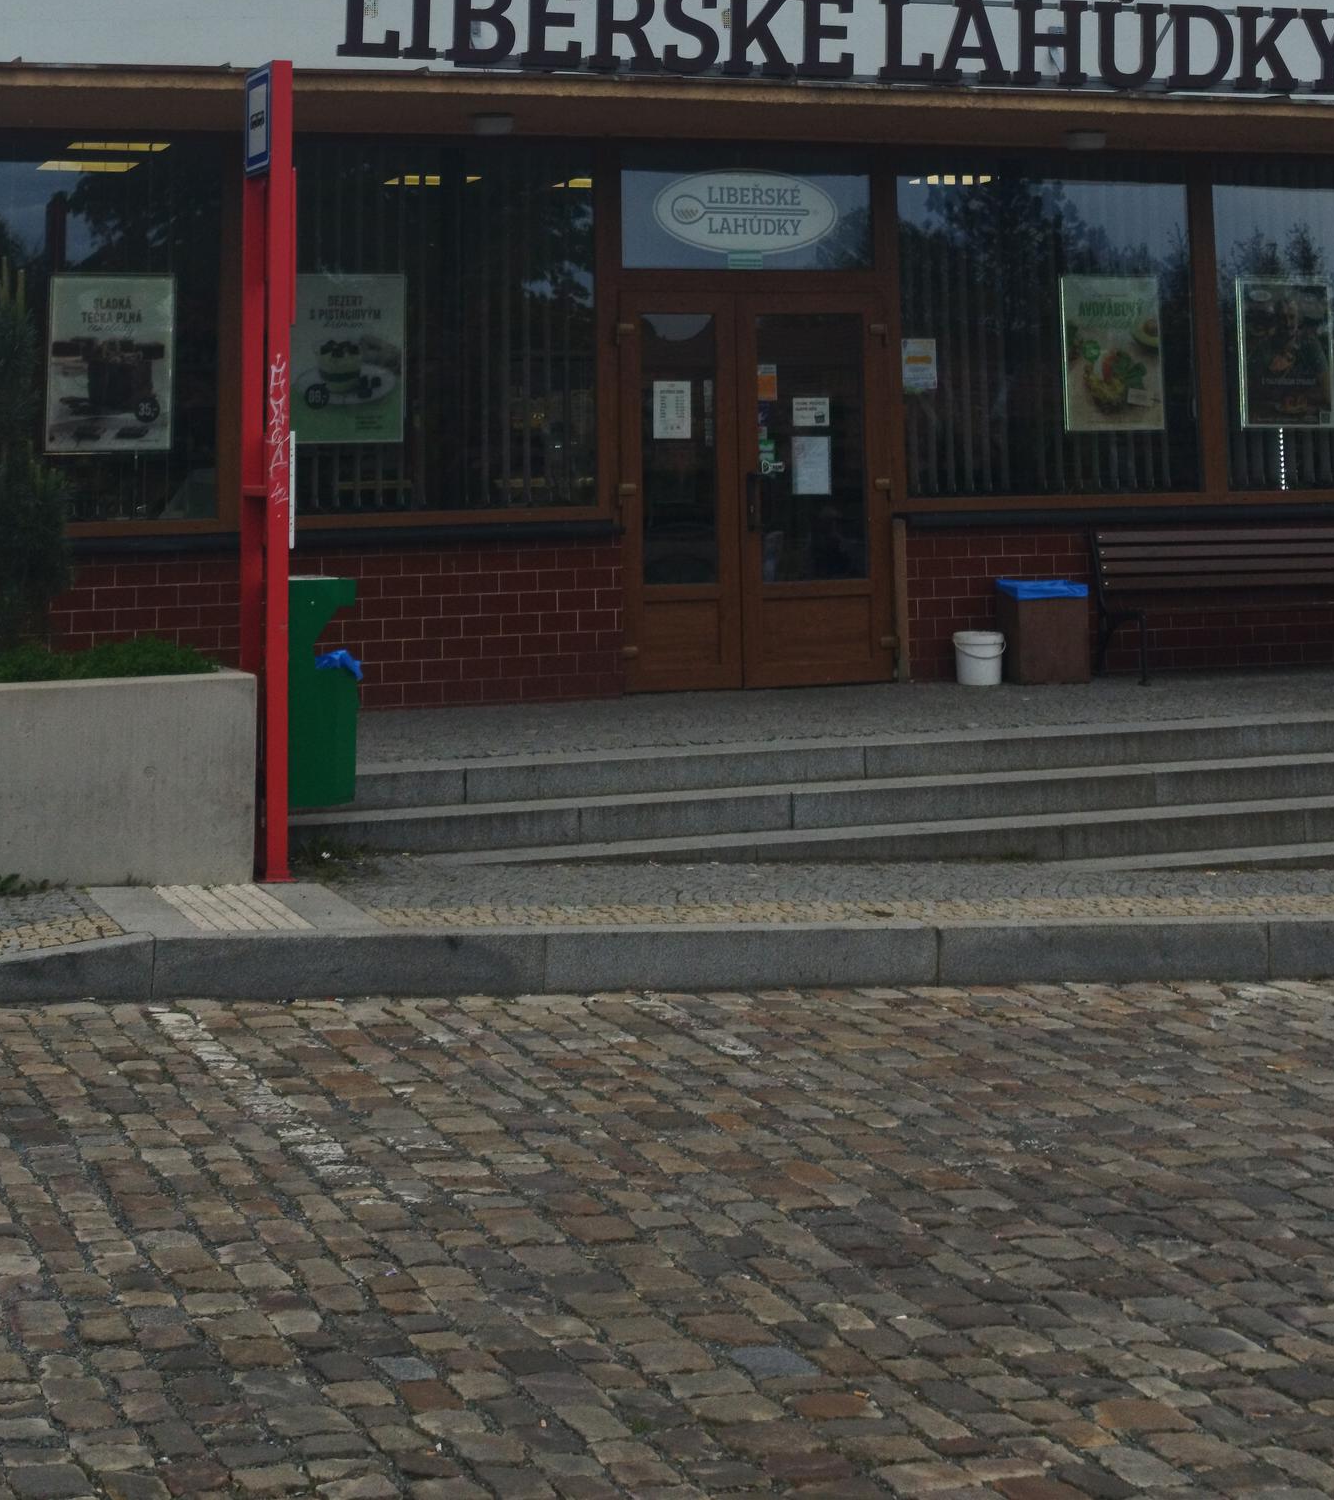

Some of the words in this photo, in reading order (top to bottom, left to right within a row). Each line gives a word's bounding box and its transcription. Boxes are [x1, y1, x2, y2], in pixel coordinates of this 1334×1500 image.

[707, 183, 801, 206] LIBEŘSKÉ
[93, 296, 132, 309] SLADKÁ
[327, 295, 364, 307] DEZERT
[116, 309, 142, 323] PLNÁ
[309, 309, 315, 320] S
